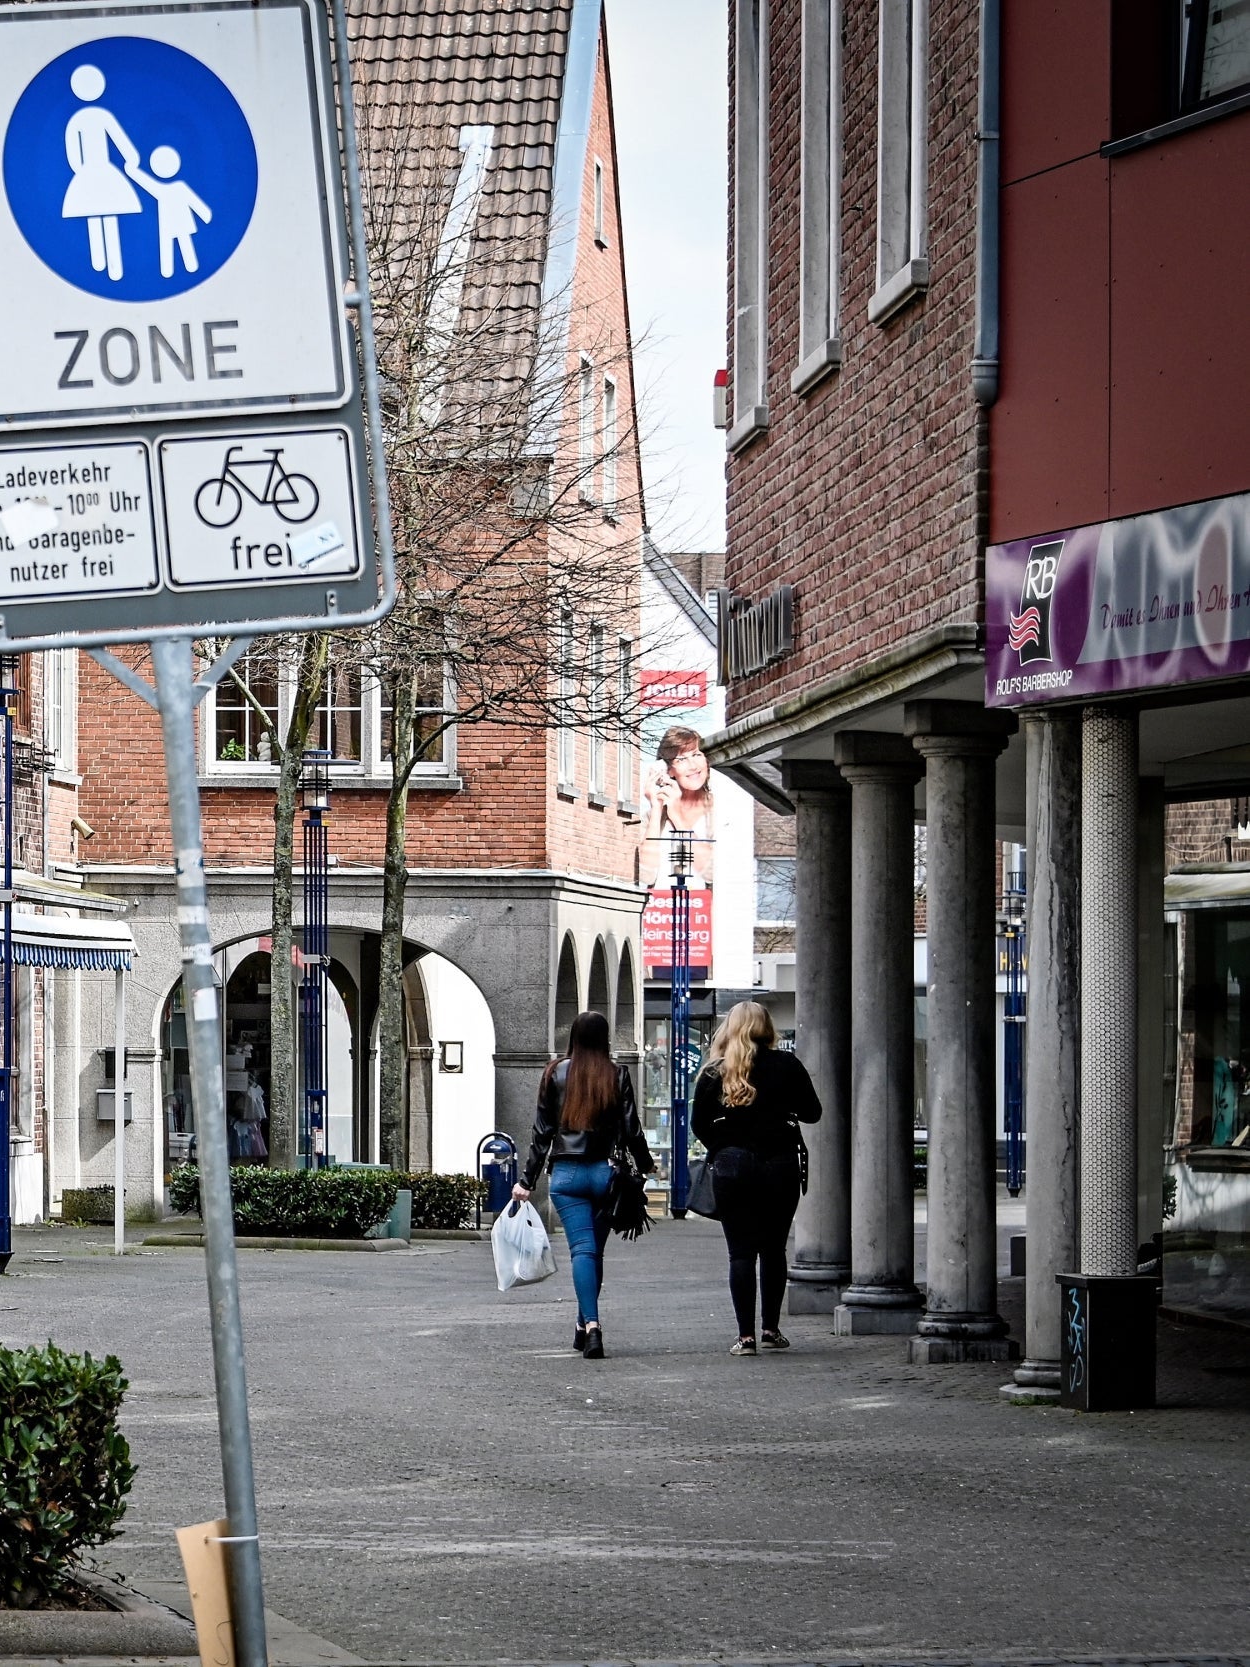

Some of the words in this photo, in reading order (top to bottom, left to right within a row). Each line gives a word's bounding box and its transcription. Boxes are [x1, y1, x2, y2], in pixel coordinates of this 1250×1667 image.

[54, 320, 244, 390] ZONE
[110, 490, 141, 513] Uhr
[230, 532, 293, 571] frei
[10, 561, 68, 583] nutzer
[82, 554, 114, 578] frei
[1025, 556, 1057, 600] RB
[1100, 603, 1133, 630] Damit
[996, 676, 1021, 696] ROLF'S
[1022, 669, 1073, 692] BARBERSHOP
[695, 912, 708, 924] in
